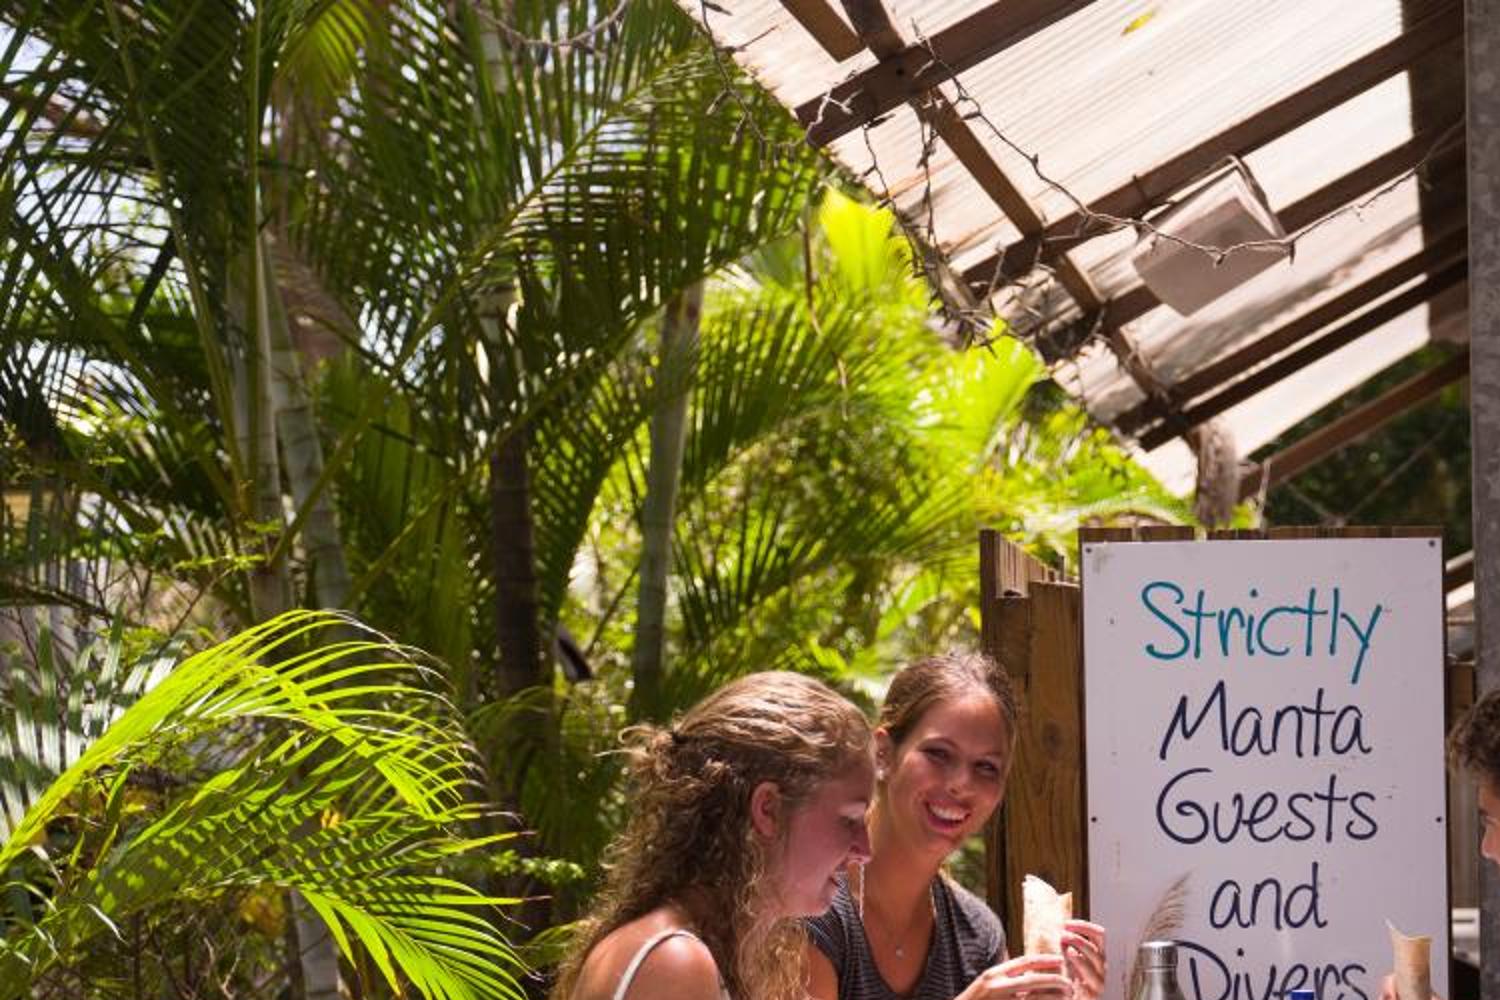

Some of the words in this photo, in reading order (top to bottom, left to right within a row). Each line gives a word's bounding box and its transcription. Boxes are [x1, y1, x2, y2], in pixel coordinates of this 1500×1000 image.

[1141, 581, 1383, 686] Strictly
[1158, 679, 1373, 761] Manta
[1155, 767, 1379, 845] Guests
[1209, 861, 1329, 931] and
